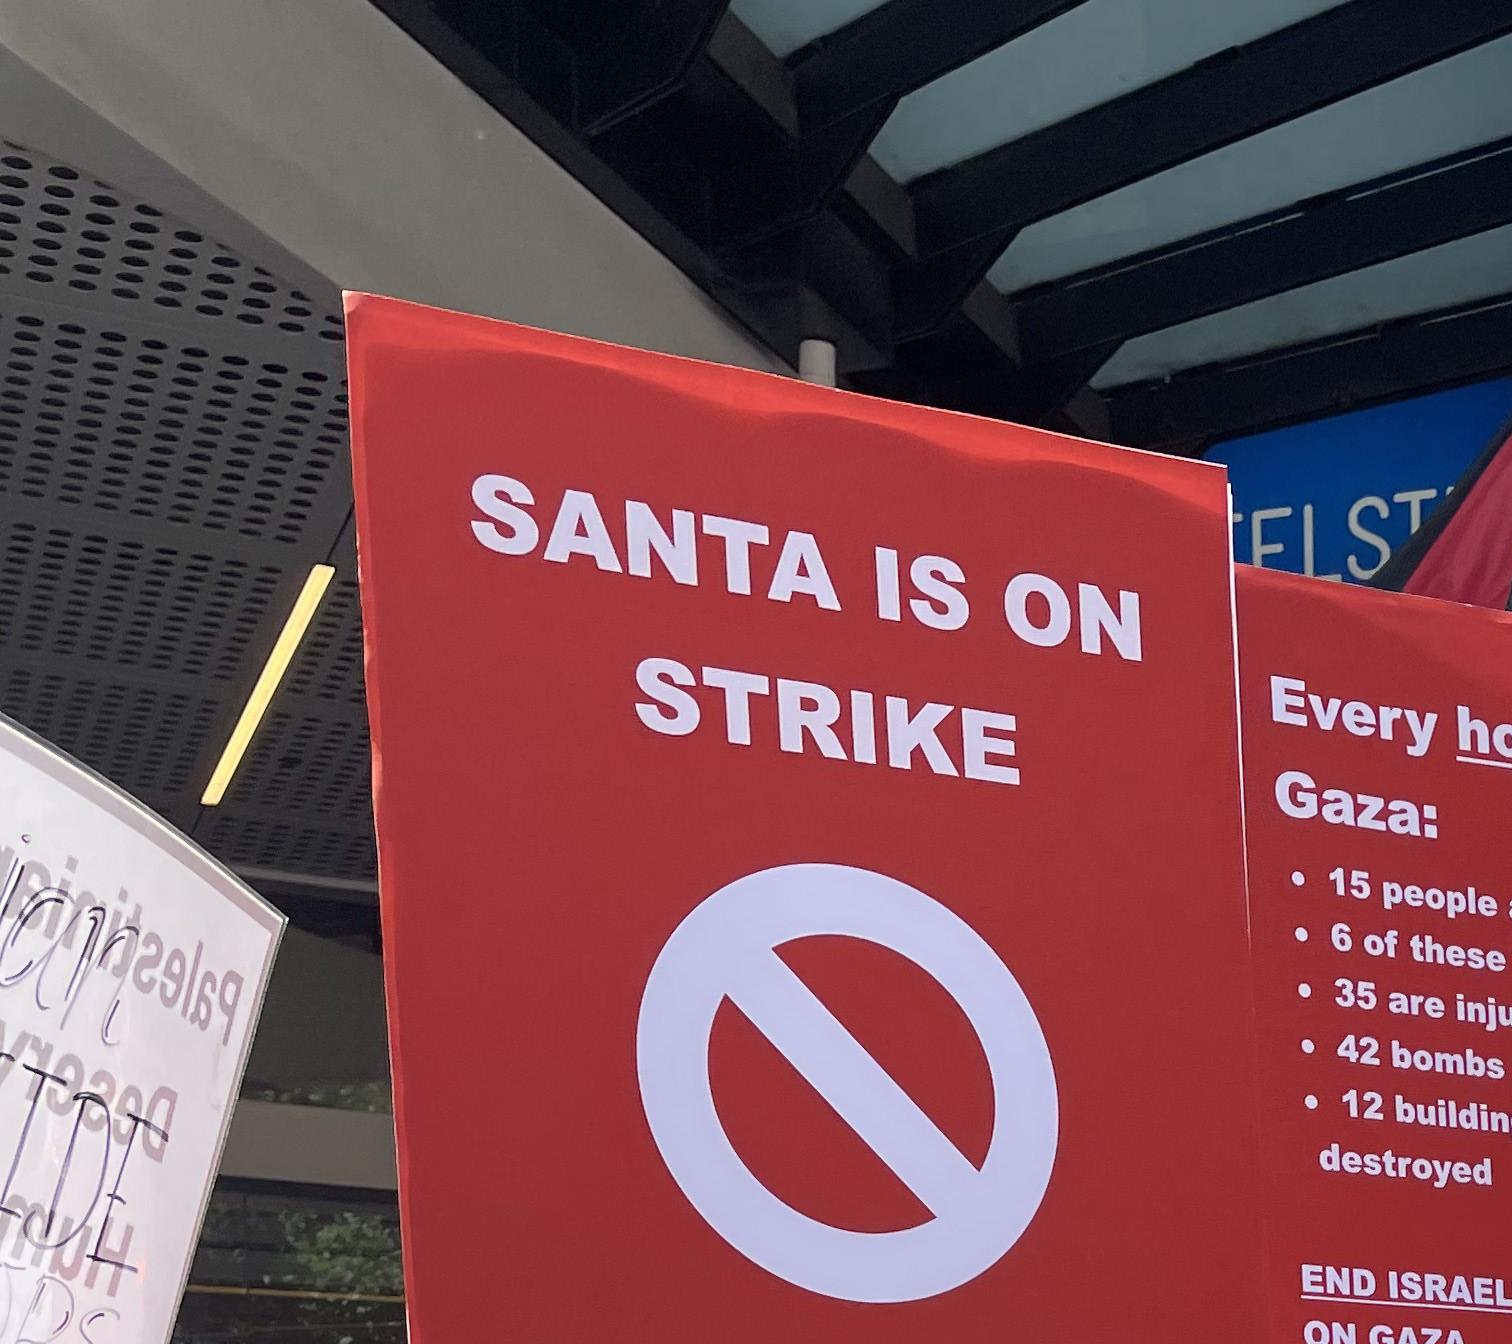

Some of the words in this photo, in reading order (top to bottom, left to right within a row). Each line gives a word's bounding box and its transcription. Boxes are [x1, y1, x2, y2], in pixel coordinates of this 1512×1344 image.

[471, 474, 841, 611] SANTA
[875, 547, 969, 630] IS
[1005, 573, 1142, 661] ON
[635, 658, 1020, 785] STRIKE
[1271, 676, 1437, 756] Every
[1275, 771, 1437, 838] Gaza:
[1329, 868, 1370, 899] 15
[1383, 882, 1497, 918] people
[1332, 923, 1352, 951] 6
[1364, 930, 1398, 957] of
[1410, 935, 1506, 971] these
[1335, 978, 1376, 1009] 35
[1389, 993, 1445, 1018] are
[1337, 1035, 1380, 1065] 42
[1392, 1040, 1504, 1079] bombs
[1343, 1089, 1384, 1120] 12
[1320, 1144, 1492, 1188] destroyed
[1302, 1264, 1375, 1296] END
